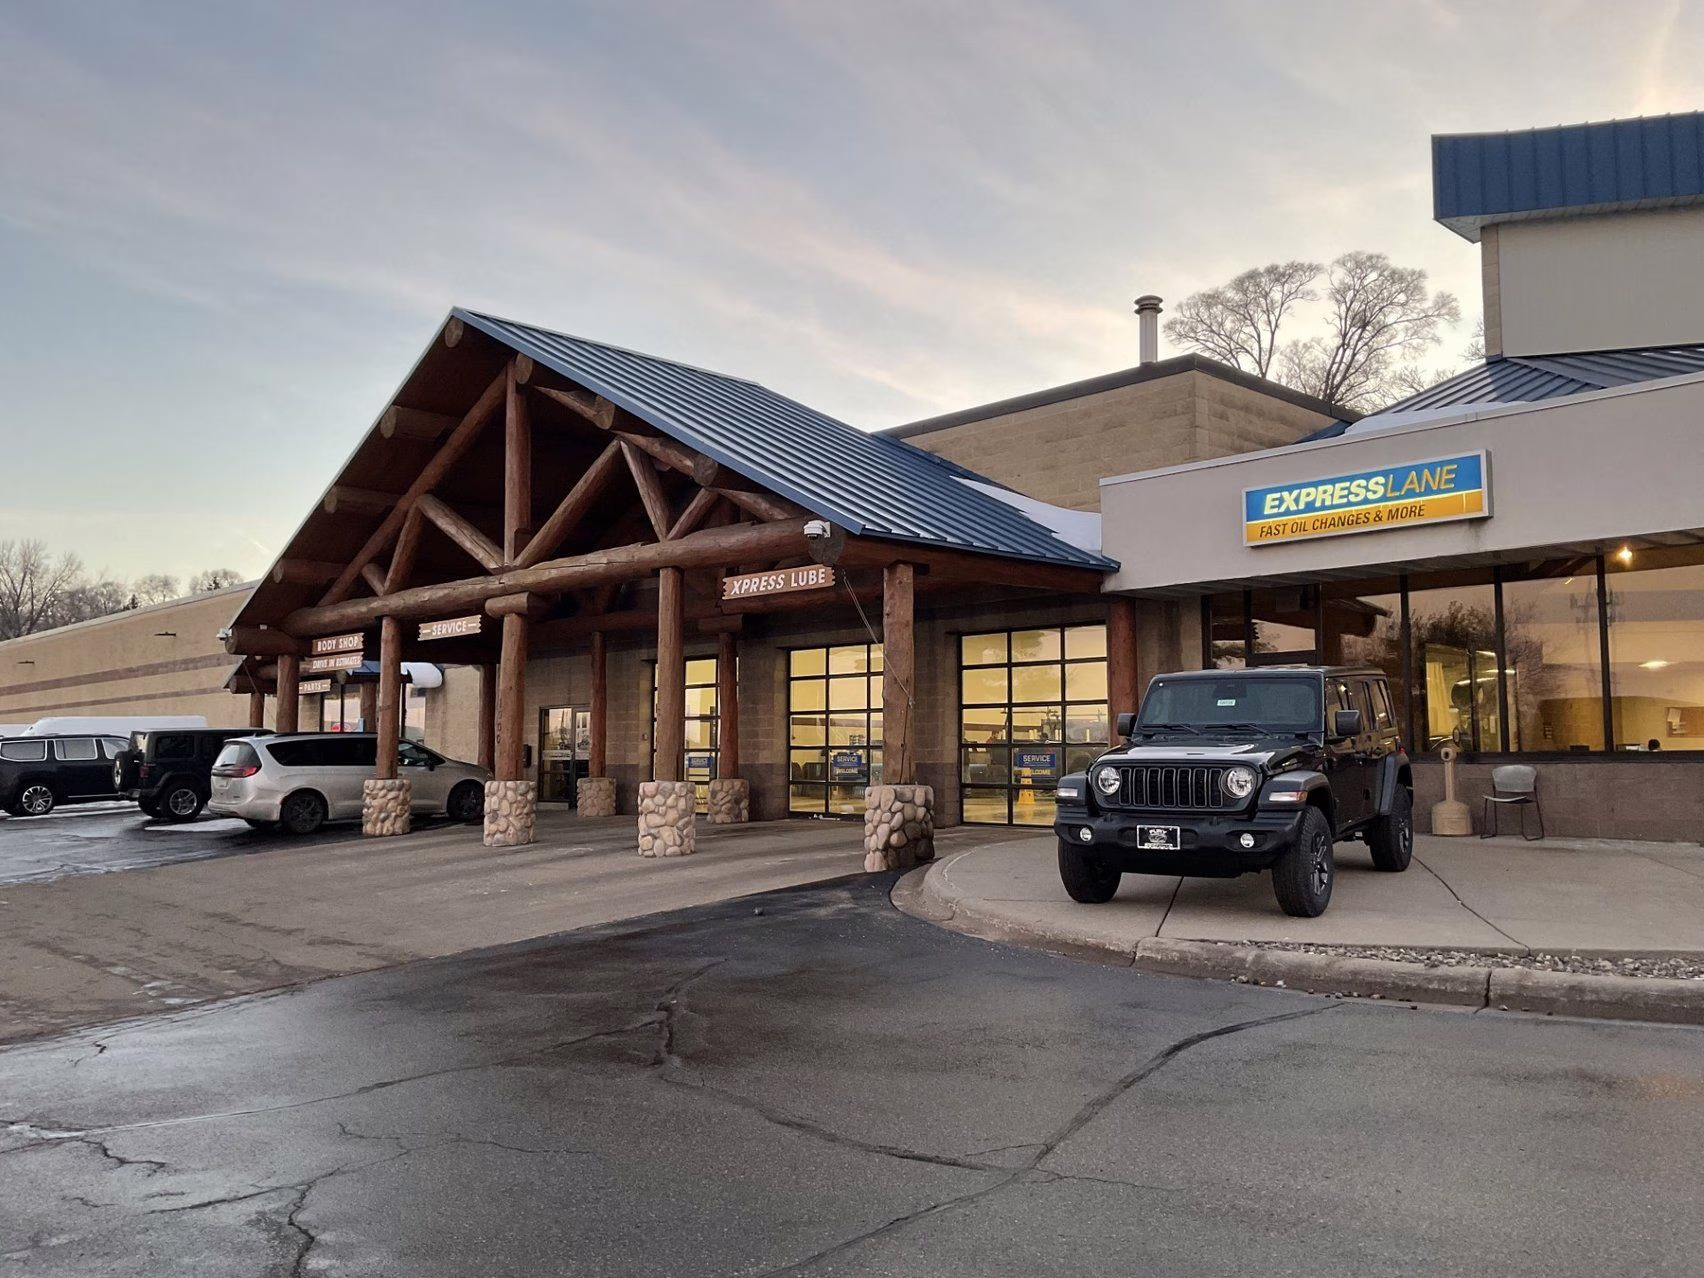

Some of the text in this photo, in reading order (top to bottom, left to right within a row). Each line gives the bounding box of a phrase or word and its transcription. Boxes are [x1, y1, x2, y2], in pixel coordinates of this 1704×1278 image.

[1259, 504, 1426, 538] FAST OIL CHANGES & MORE
[730, 568, 826, 595] XPRESS LUBE
[432, 621, 467, 636] SERVICE
[317, 636, 359, 652] BODY SHOP
[304, 682, 321, 691] PARTS
[1022, 754, 1051, 762] SERVICE
